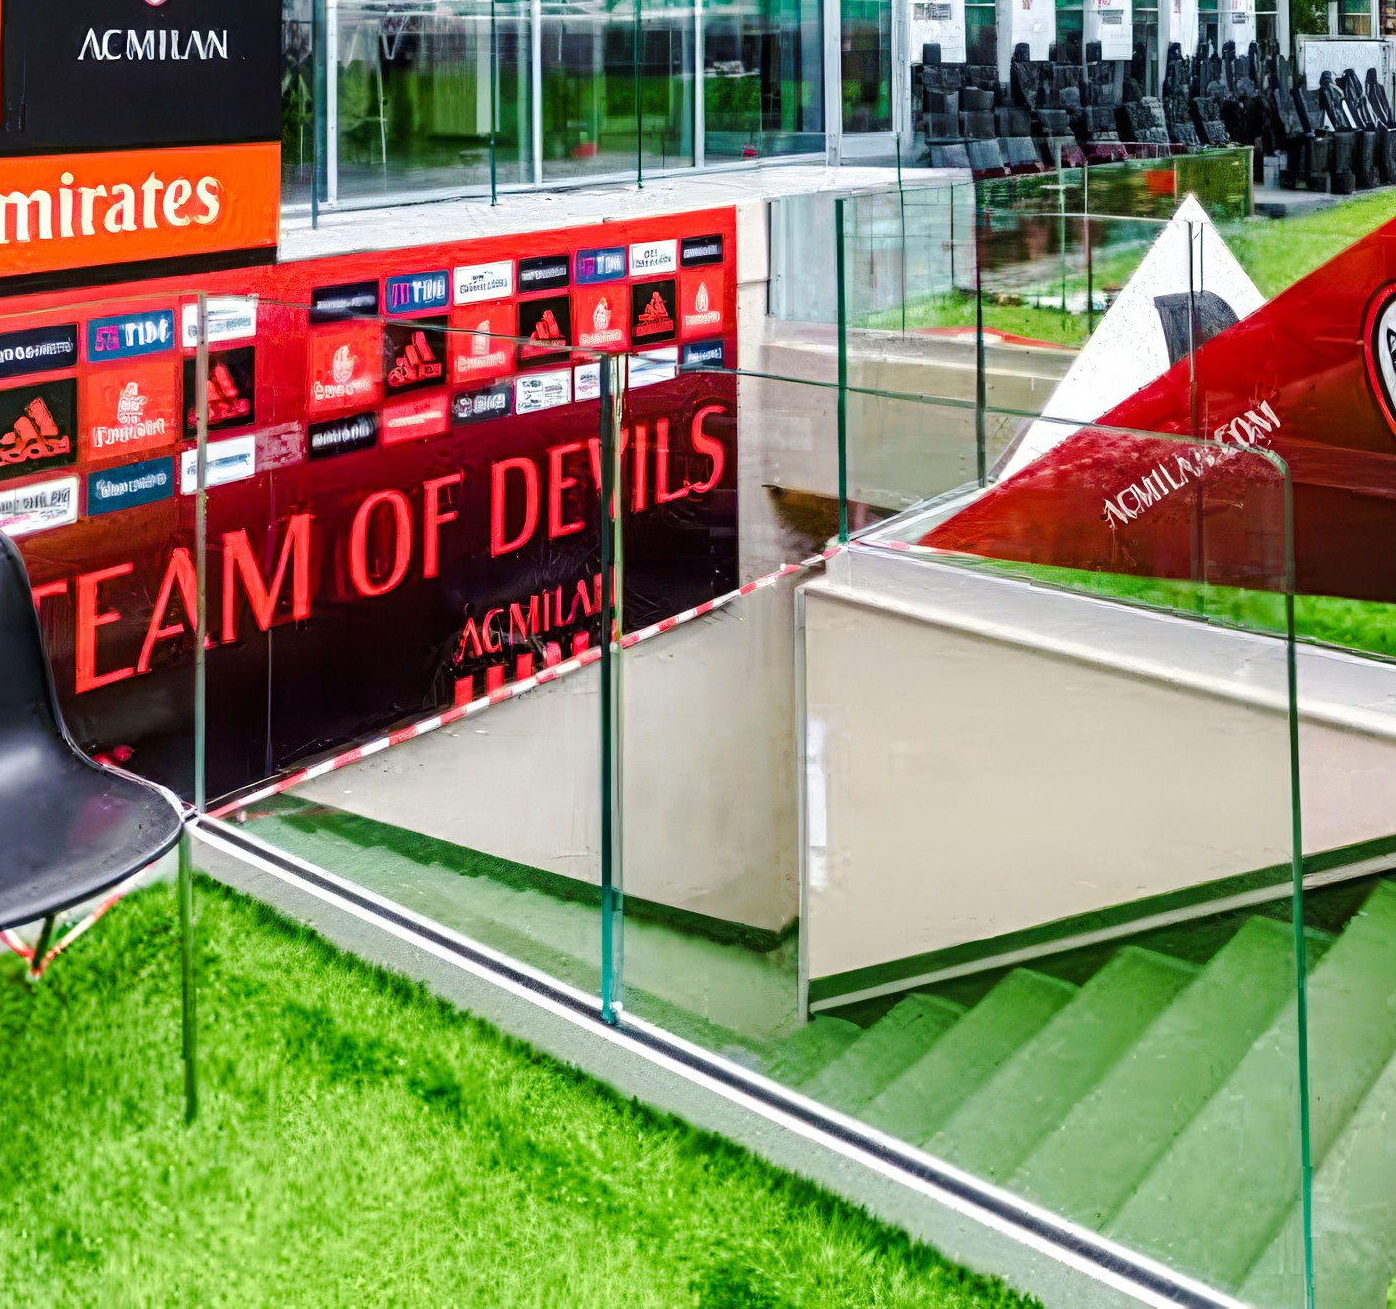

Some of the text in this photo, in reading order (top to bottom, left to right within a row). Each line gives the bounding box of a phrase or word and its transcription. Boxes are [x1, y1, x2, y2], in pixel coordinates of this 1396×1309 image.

[32, 514, 313, 695] EAM
[351, 473, 462, 596] OF
[490, 404, 726, 559] DEVILS
